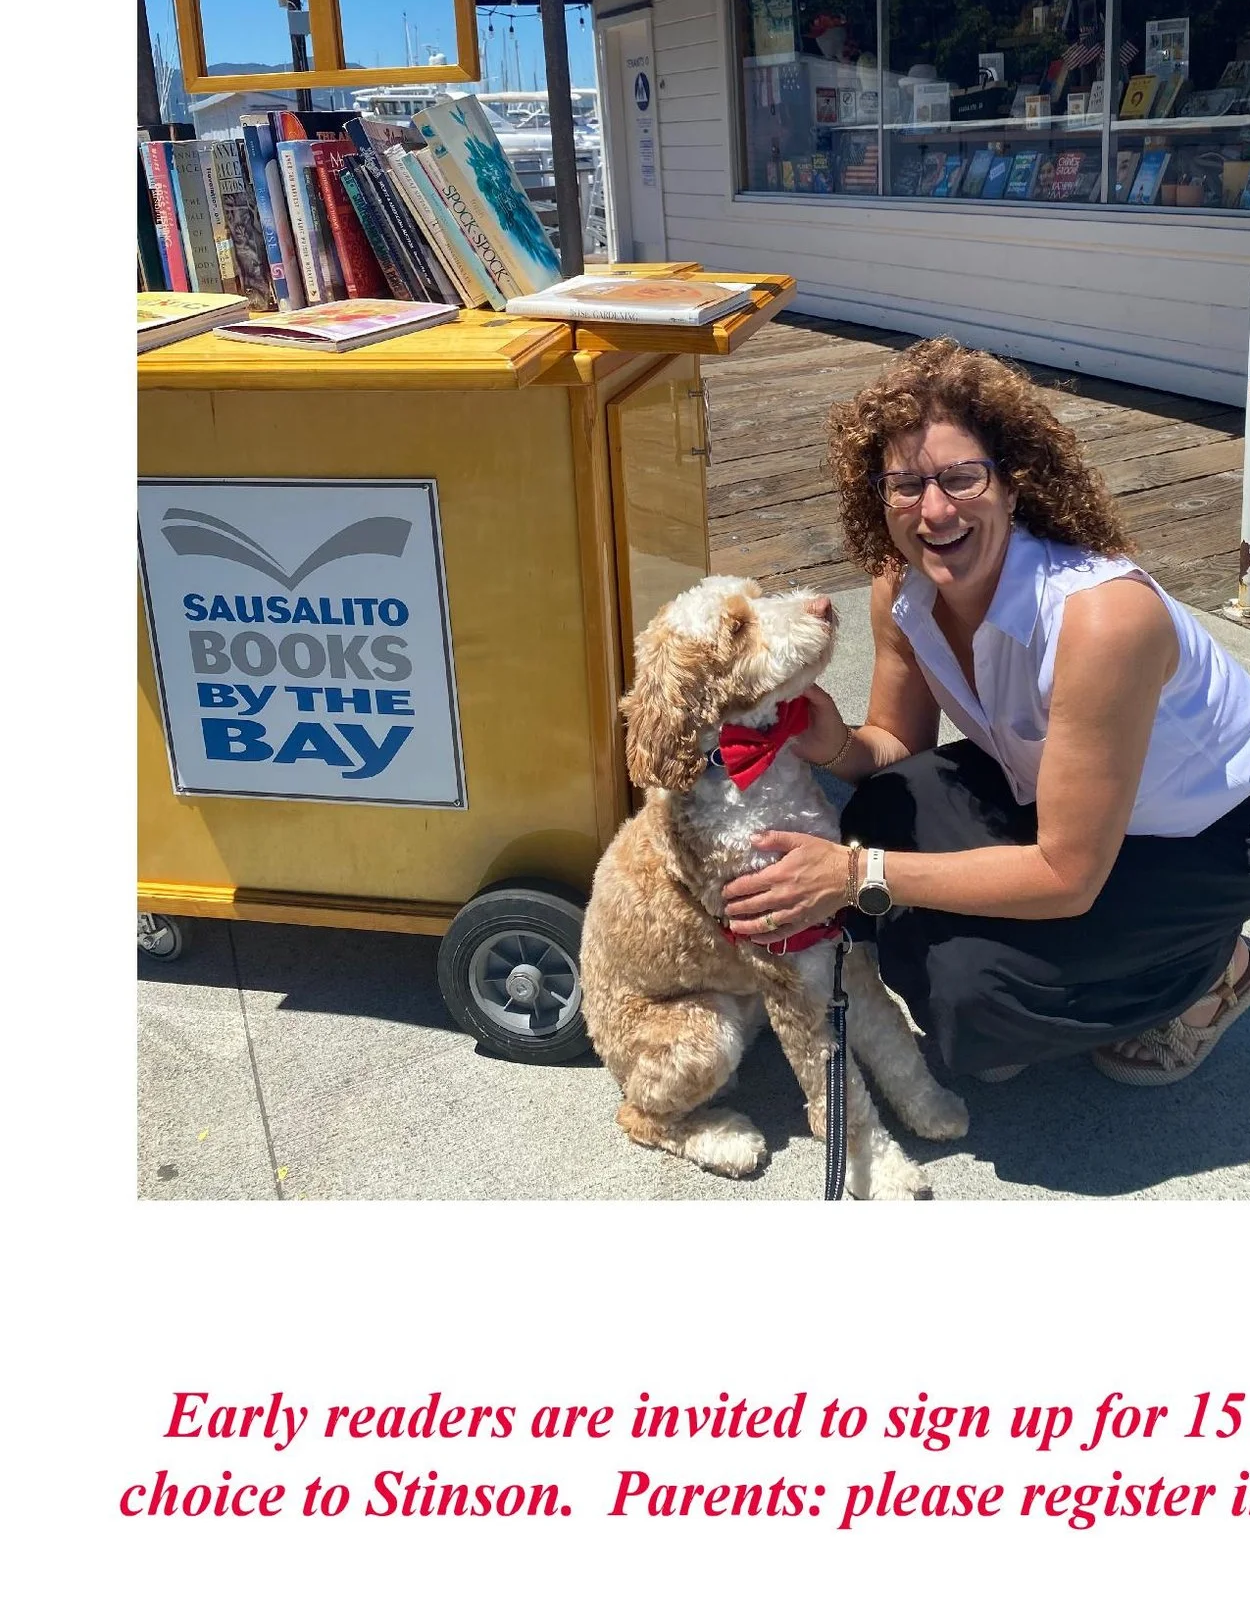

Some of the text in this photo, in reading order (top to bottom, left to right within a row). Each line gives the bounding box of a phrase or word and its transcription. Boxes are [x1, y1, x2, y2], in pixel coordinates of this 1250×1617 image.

[183, 593, 409, 626] SAUSALITO
[189, 630, 412, 682] BOOKS
[285, 686, 415, 716] THE
[164, 1392, 308, 1451] Early
[325, 1392, 516, 1438] readers
[531, 1406, 614, 1438] are
[632, 1392, 807, 1438] invited
[821, 1398, 867, 1438] to
[884, 1392, 989, 1451] sign
[1011, 1407, 1072, 1451] up
[1080, 1392, 1168, 1451] for
[1184, 1392, 1245, 1438] 15
[120, 1470, 285, 1516] choice
[303, 1477, 349, 1516] to
[365, 1471, 571, 1516] Stinson.
[608, 1471, 825, 1516] Parents:
[837, 1471, 1004, 1529] please
[1021, 1471, 1216, 1530] register
